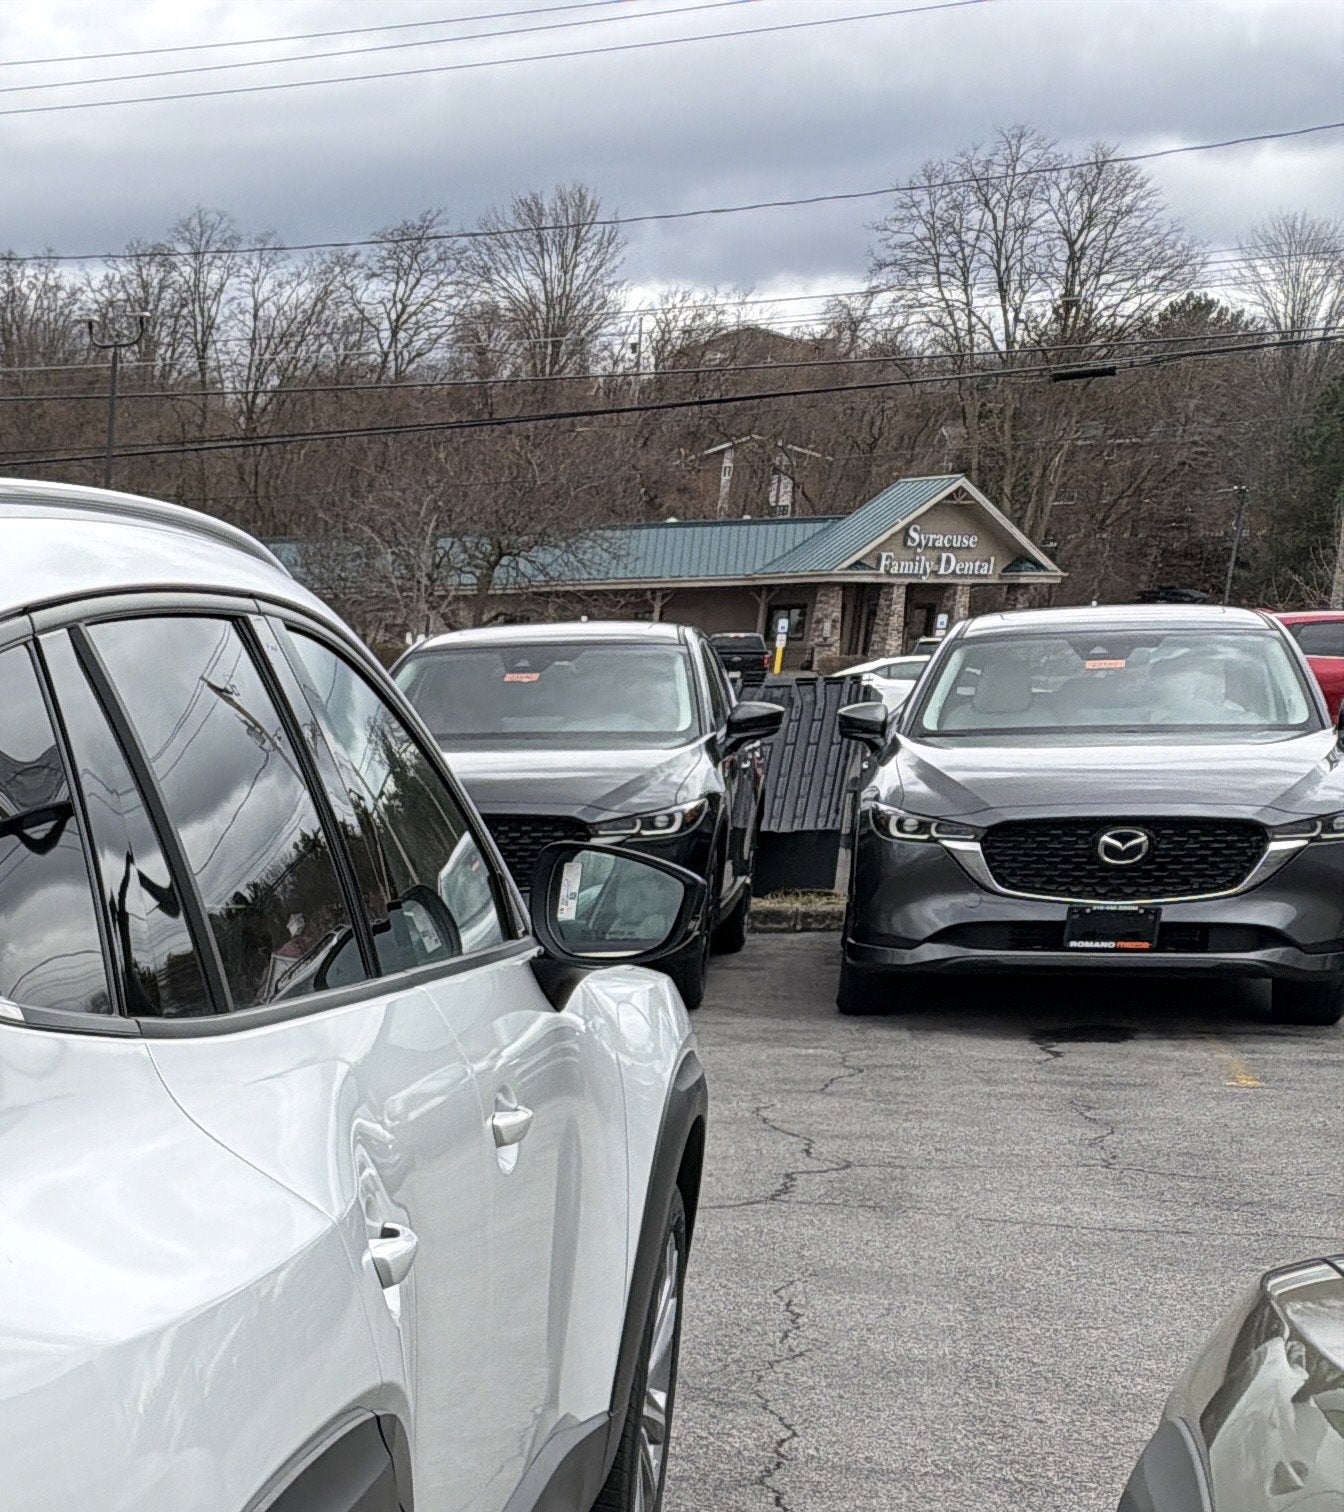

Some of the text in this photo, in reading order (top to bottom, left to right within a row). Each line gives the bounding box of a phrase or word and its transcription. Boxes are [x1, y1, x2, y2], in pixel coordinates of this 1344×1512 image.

[907, 525, 978, 551] Syracuse
[879, 552, 995, 579] Family Dental
